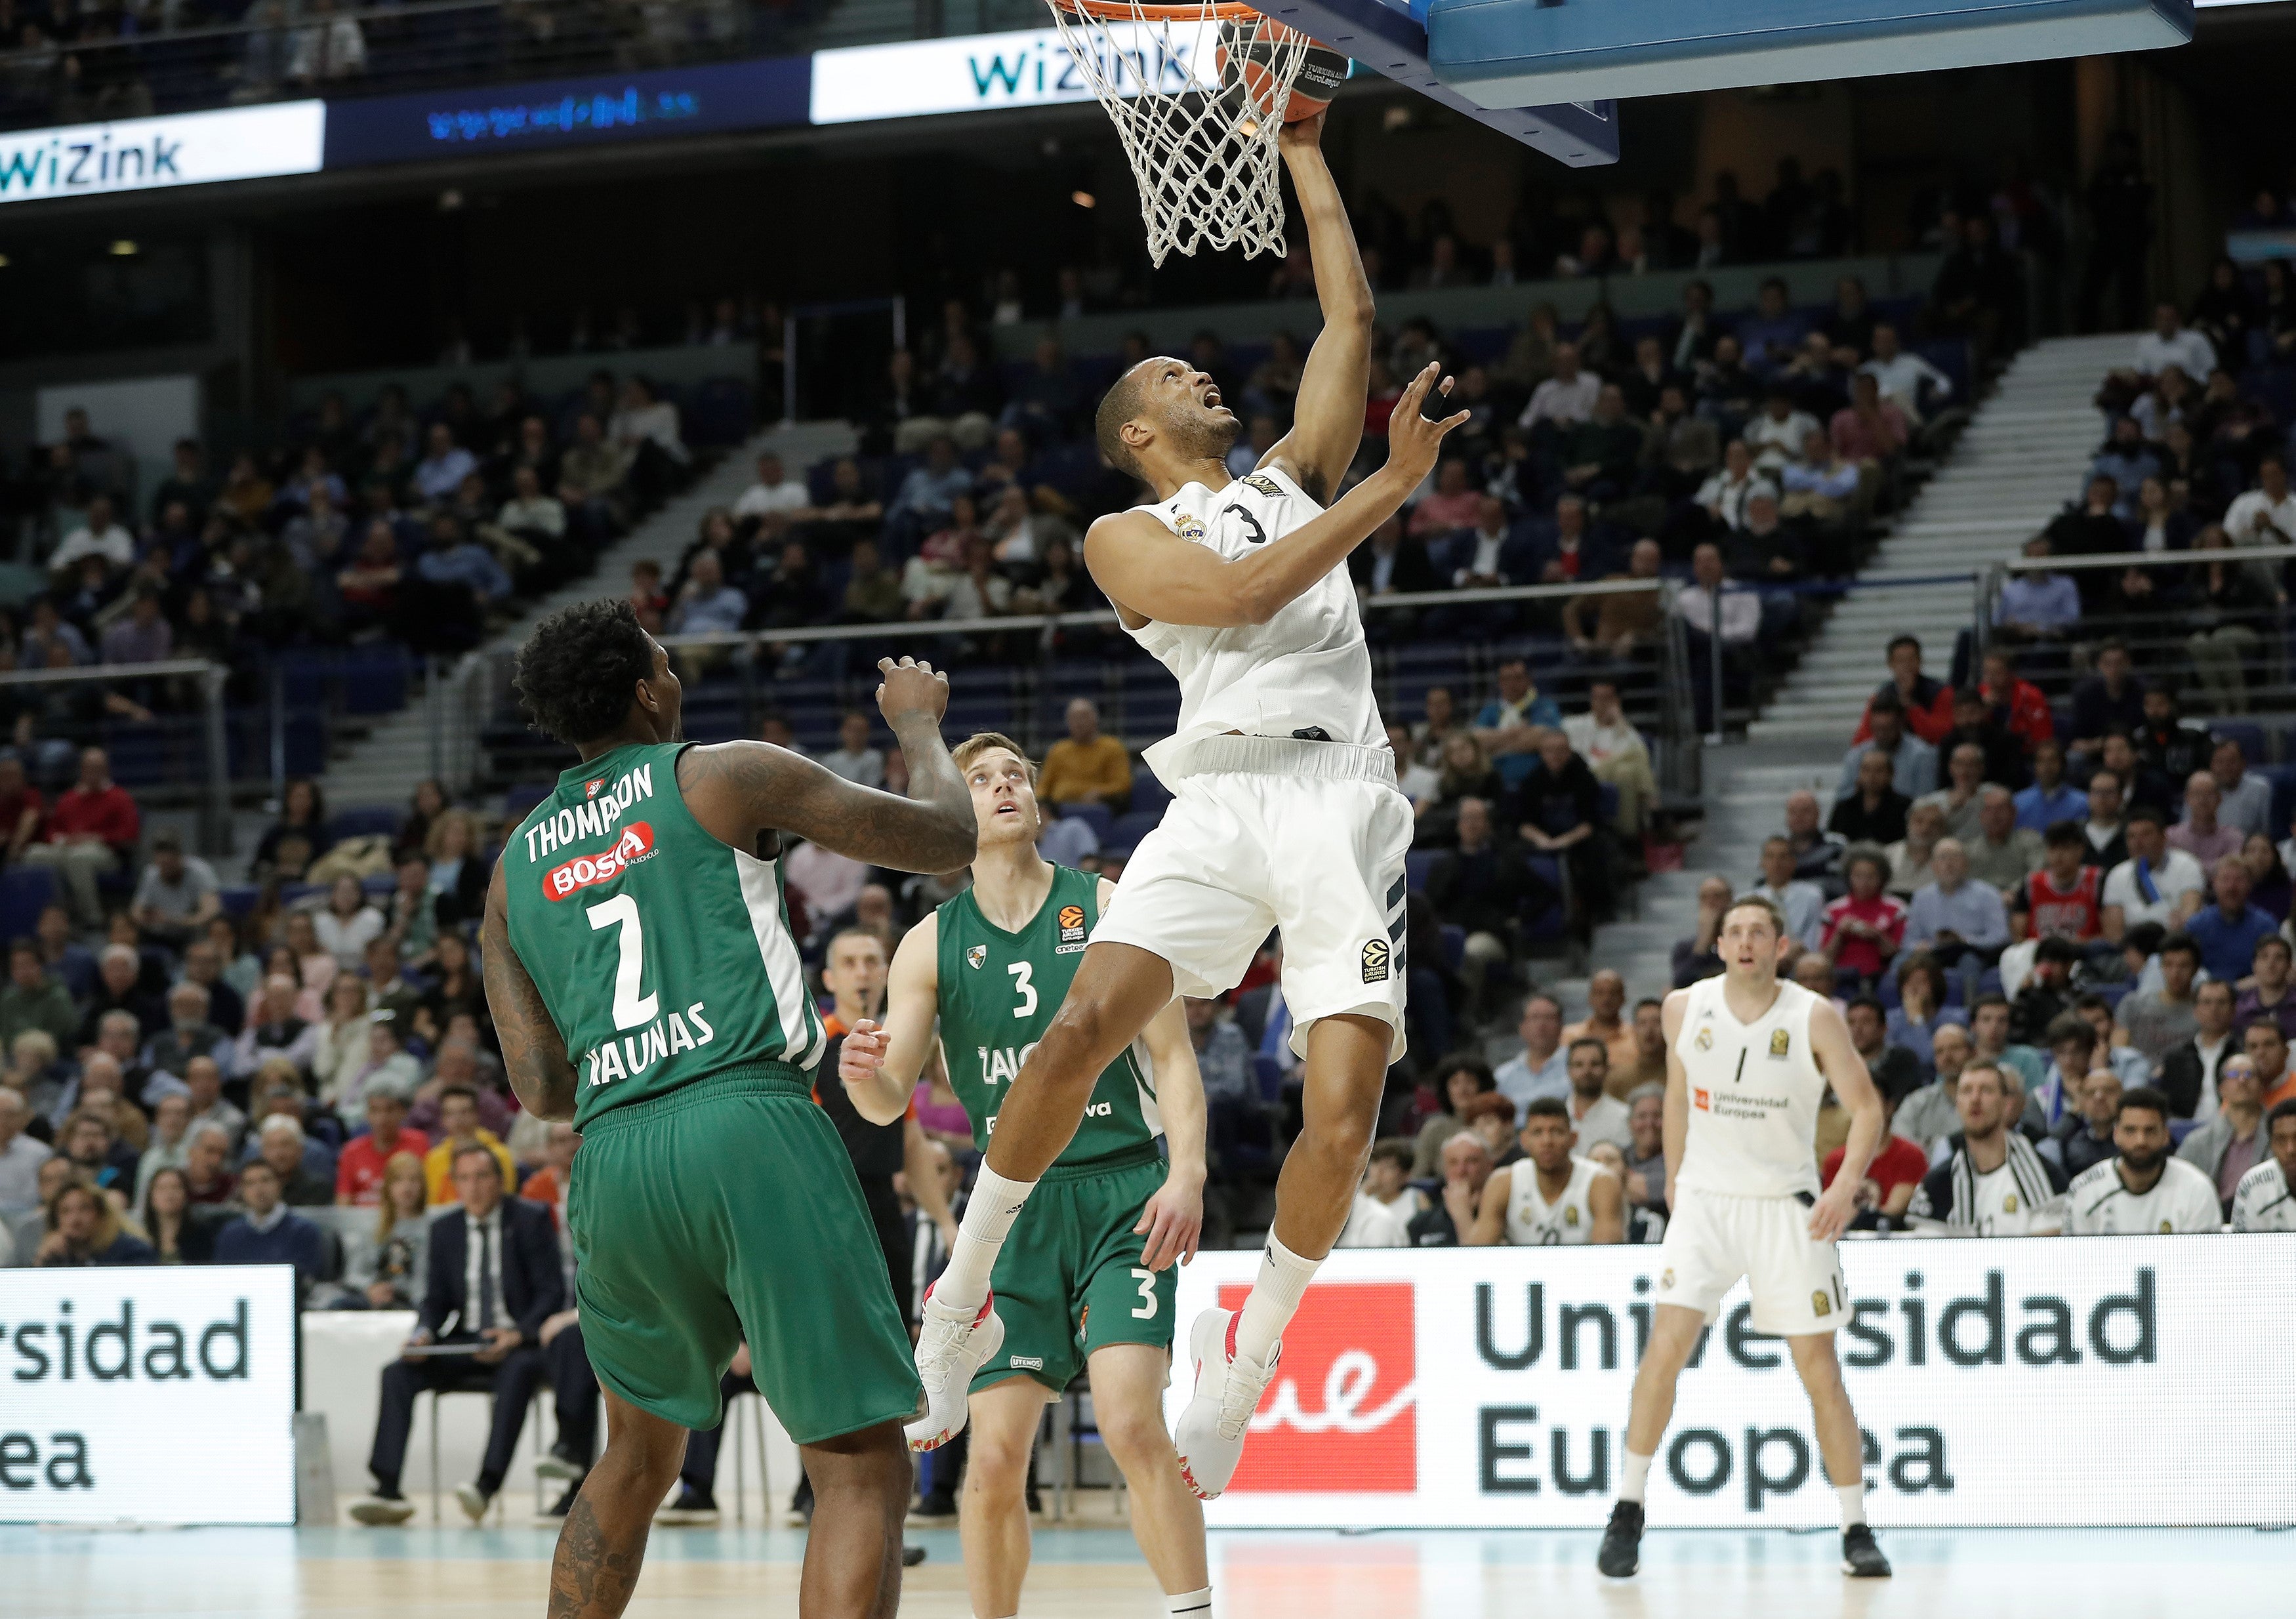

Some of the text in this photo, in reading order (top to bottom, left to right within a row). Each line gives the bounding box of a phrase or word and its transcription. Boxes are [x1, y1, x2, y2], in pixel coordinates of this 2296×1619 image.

[970, 35, 1186, 96] WiZink
[0, 134, 181, 190] WiZink
[1223, 504, 1266, 544] 3
[1008, 960, 1038, 1018] 3
[1713, 1091, 1789, 1109] Universidad
[1713, 1103, 1767, 1120] Europea
[1131, 1268, 1158, 1319] 3
[0, 1297, 249, 1380] sidad
[1012, 1358, 1041, 1368] UTENOS
